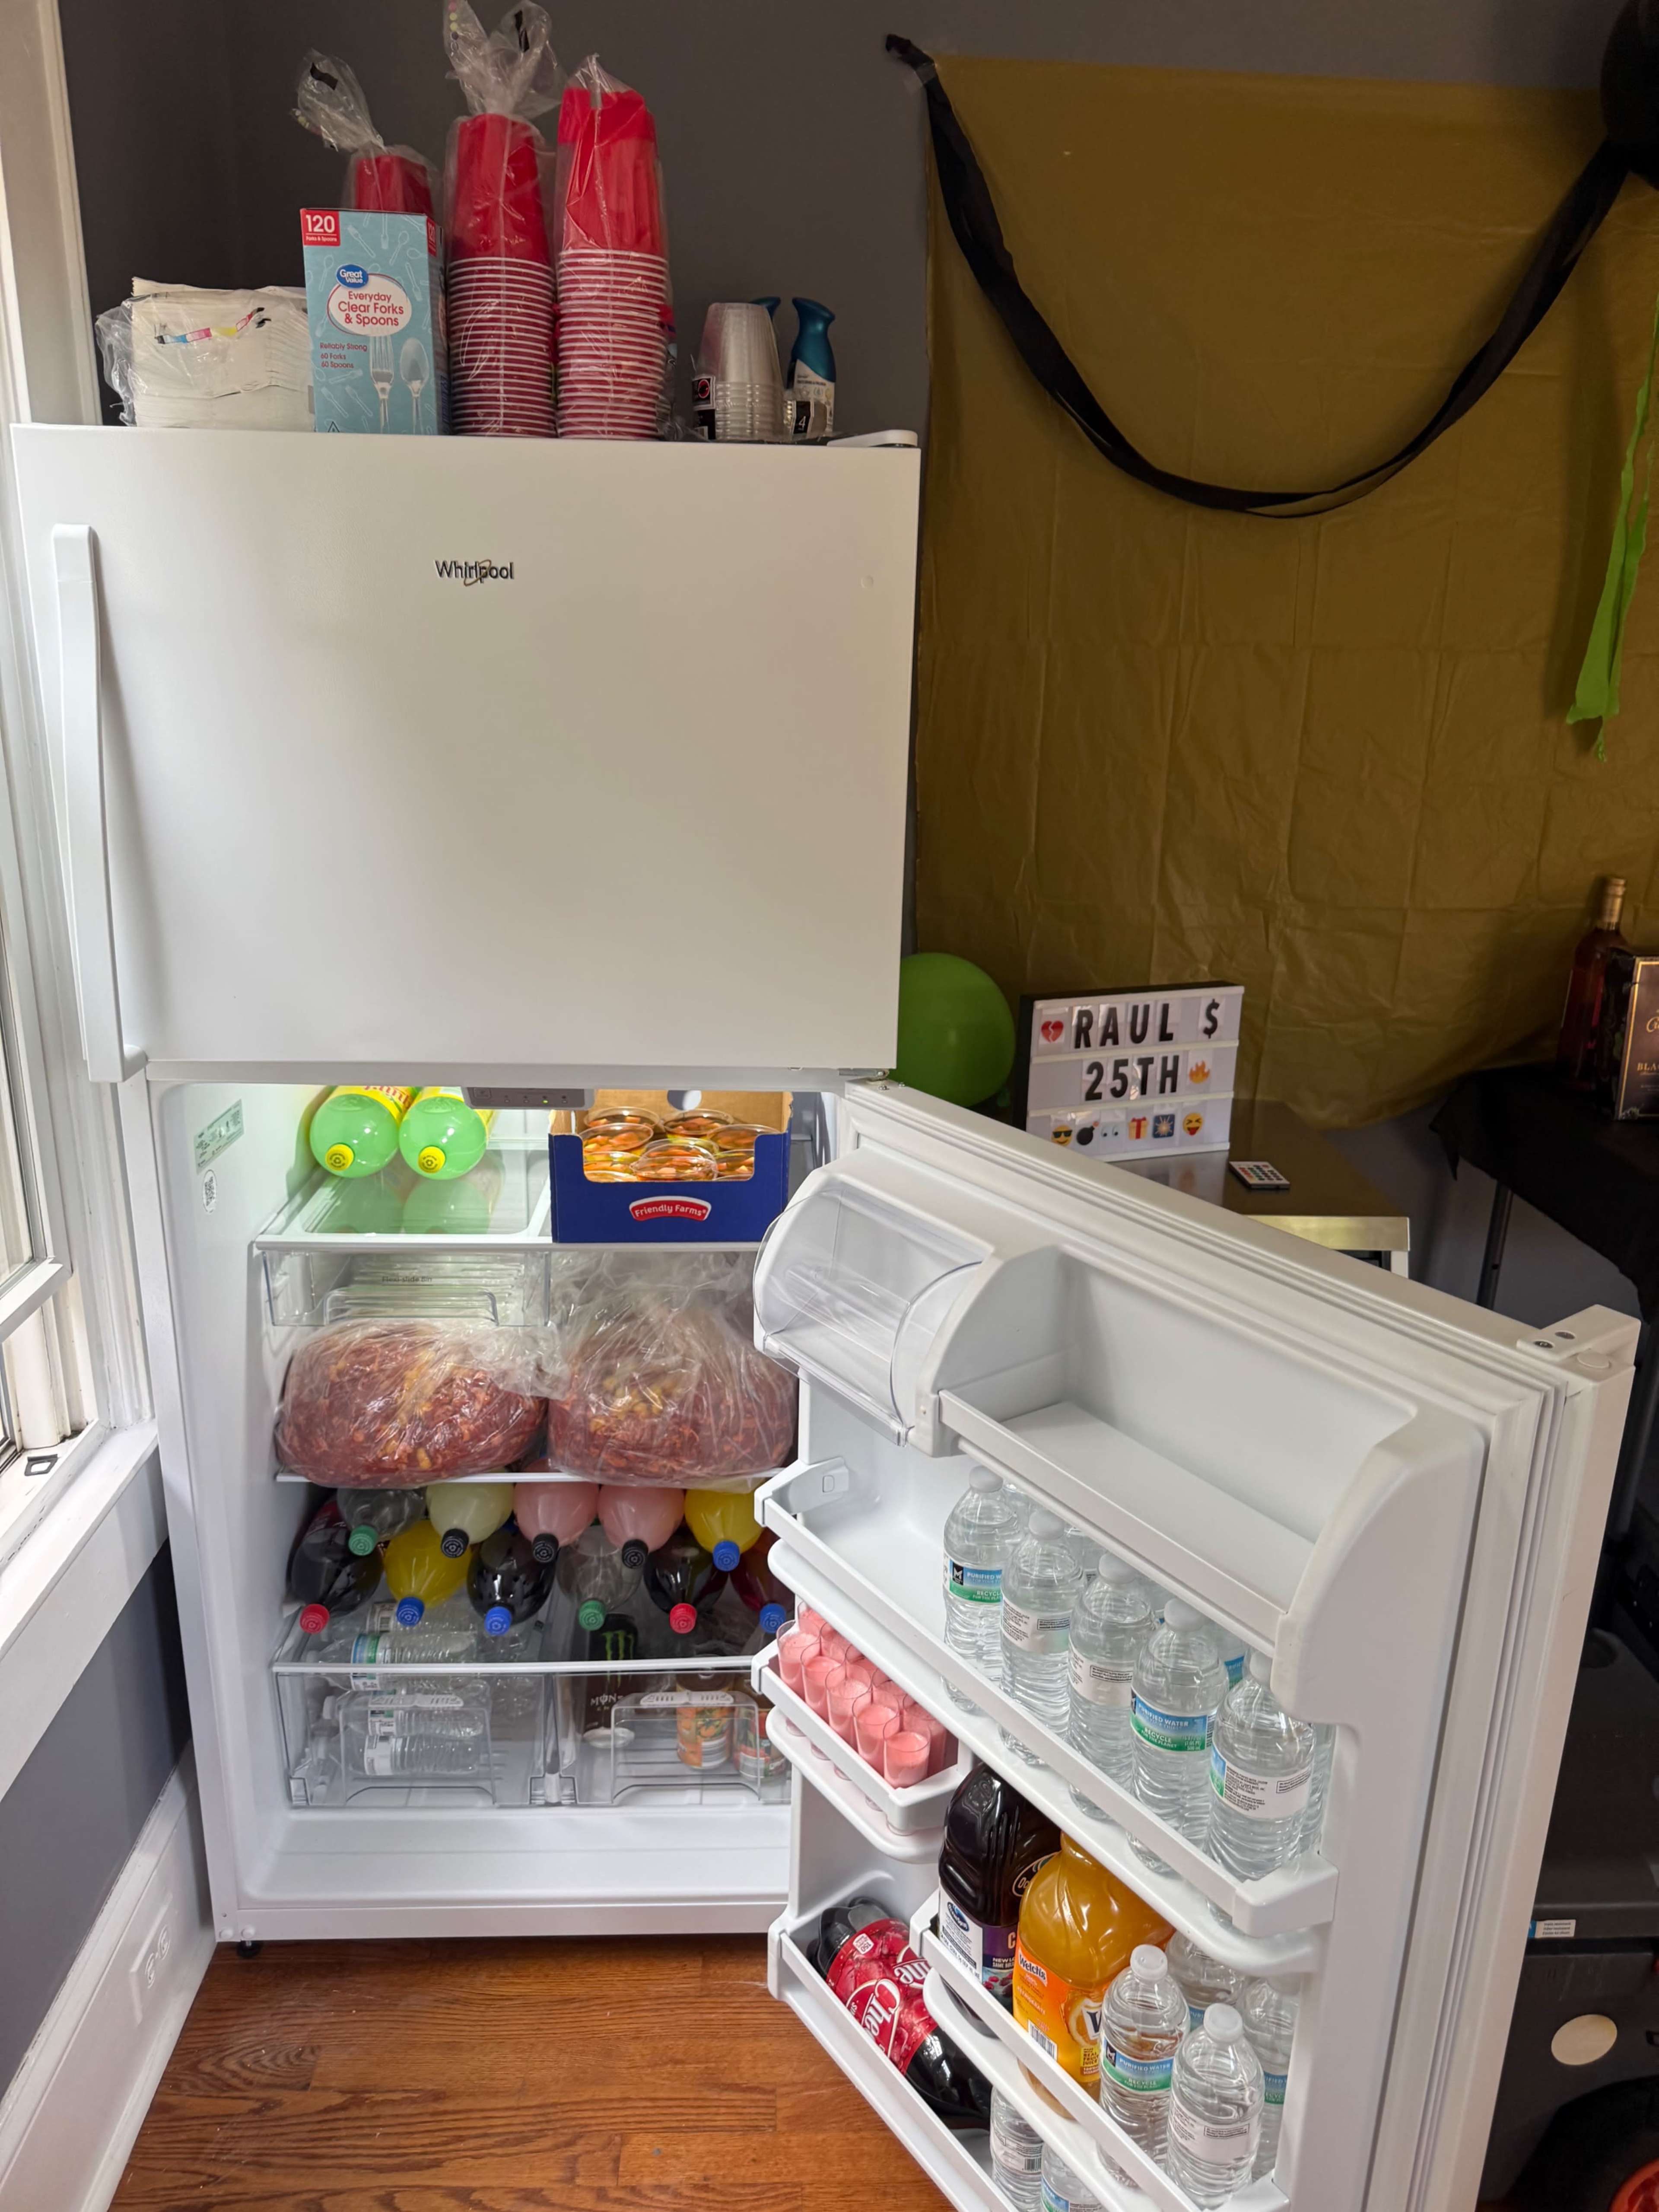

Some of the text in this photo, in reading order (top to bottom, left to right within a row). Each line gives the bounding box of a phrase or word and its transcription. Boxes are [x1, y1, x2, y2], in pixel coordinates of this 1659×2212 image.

[305, 214, 335, 233] 120
[340, 269, 362, 278] Great
[348, 291, 391, 302] Everyday
[338, 301, 404, 315] Clear Forks
[344, 313, 399, 327] & Spoons
[346, 343, 367, 352] Strong
[434, 560, 514, 584] Whirlpool
[1074, 998, 1220, 1049] RAUL $
[1085, 1054, 1180, 1101] 25TH
[634, 1204, 673, 1217] Friendly
[1138, 1703, 1163, 1722] PURIFIED
[1144, 1727, 1172, 1743] RECYCLE
[1019, 1954, 1046, 1981] Welch's
[1119, 2057, 1148, 2071] PURIFIED
